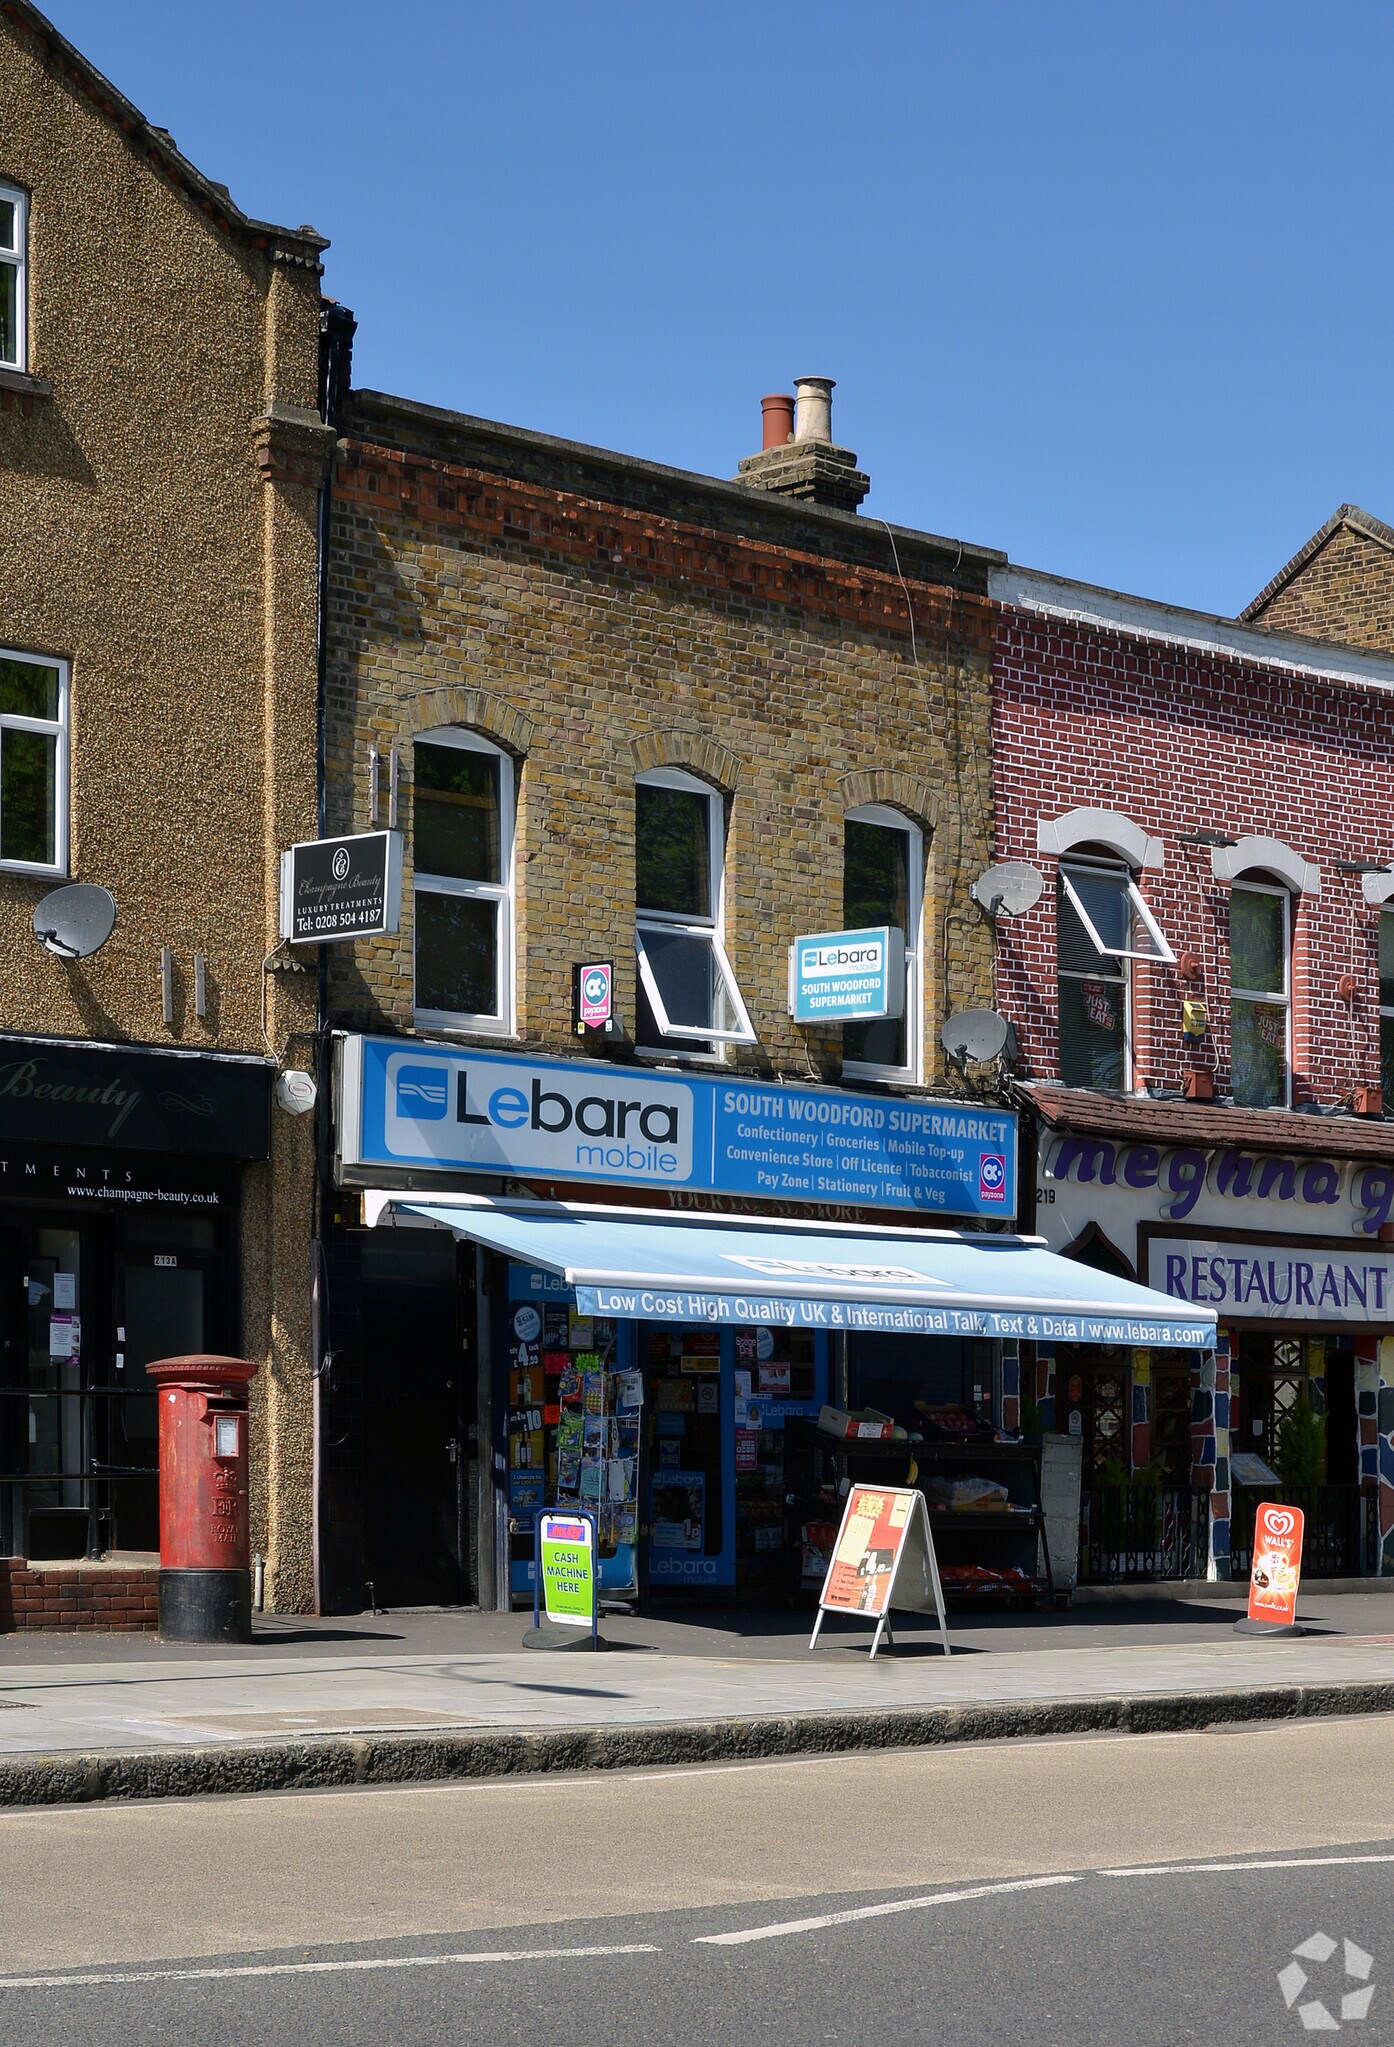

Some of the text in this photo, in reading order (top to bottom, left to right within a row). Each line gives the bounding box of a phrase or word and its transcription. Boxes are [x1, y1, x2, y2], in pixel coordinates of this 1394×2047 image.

[299, 872, 382, 902] Champagne Beauty
[297, 897, 382, 915] LUXURY TREATMENTS
[297, 909, 381, 931] Tel: 0208 504 4187
[819, 949, 877, 966] Lebara
[849, 963, 877, 972] mobile
[801, 978, 881, 995] SOUTH WOODFORD
[809, 993, 872, 1008] SUPERMARKET
[1086, 994, 1109, 1012] JUST
[584, 1006, 608, 1017] payzone
[1090, 1007, 1107, 1023] EAT
[1258, 1016, 1279, 1032] JUST
[1261, 1029, 1276, 1044] EAT
[0, 1057, 142, 1137] Beauty
[456, 1069, 679, 1145] Lebara
[723, 1091, 1007, 1143] SOUTH WOODFORD SUPERMARKET
[737, 1124, 964, 1162] Confectionery Groceries Mobile Top-up
[576, 1144, 678, 1174] mobile
[726, 1146, 974, 1184] Convenience Store Off Licence Tobacconist
[1050, 1136, 1340, 1220] meghna
[67, 1185, 220, 1205] www.champagne-beauty.co.uk
[757, 1171, 946, 1205] Pay Zone Stationery Fruit & Veg
[980, 1191, 1005, 1201] payzone
[1037, 1188, 1056, 1205] 219
[668, 1190, 724, 1210] YOUR
[803, 1203, 867, 1221] STORE
[155, 1256, 177, 1267] 213A
[1166, 1254, 1389, 1310] RESTAURANT
[596, 1290, 636, 1311] Low
[641, 1293, 684, 1315] Cost
[687, 1296, 730, 1321] High
[734, 1299, 797, 1326] Quality
[799, 1303, 827, 1323] UK
[831, 1305, 844, 1324] &
[847, 1306, 948, 1331] International
[950, 1312, 987, 1335] Talk,
[990, 1315, 1024, 1334] Text
[1027, 1319, 1039, 1335] &
[1043, 1319, 1077, 1337] Data
[1088, 1323, 1205, 1344] www.lebara.com
[765, 1404, 806, 1416] Lebara
[662, 1473, 703, 1485] Lebara
[1264, 1534, 1295, 1549] WALL'S
[553, 1552, 580, 1564] CASH
[648, 1556, 717, 1574] Lebara
[546, 1566, 589, 1580] MACHINE
[556, 1581, 580, 1593] HERE
